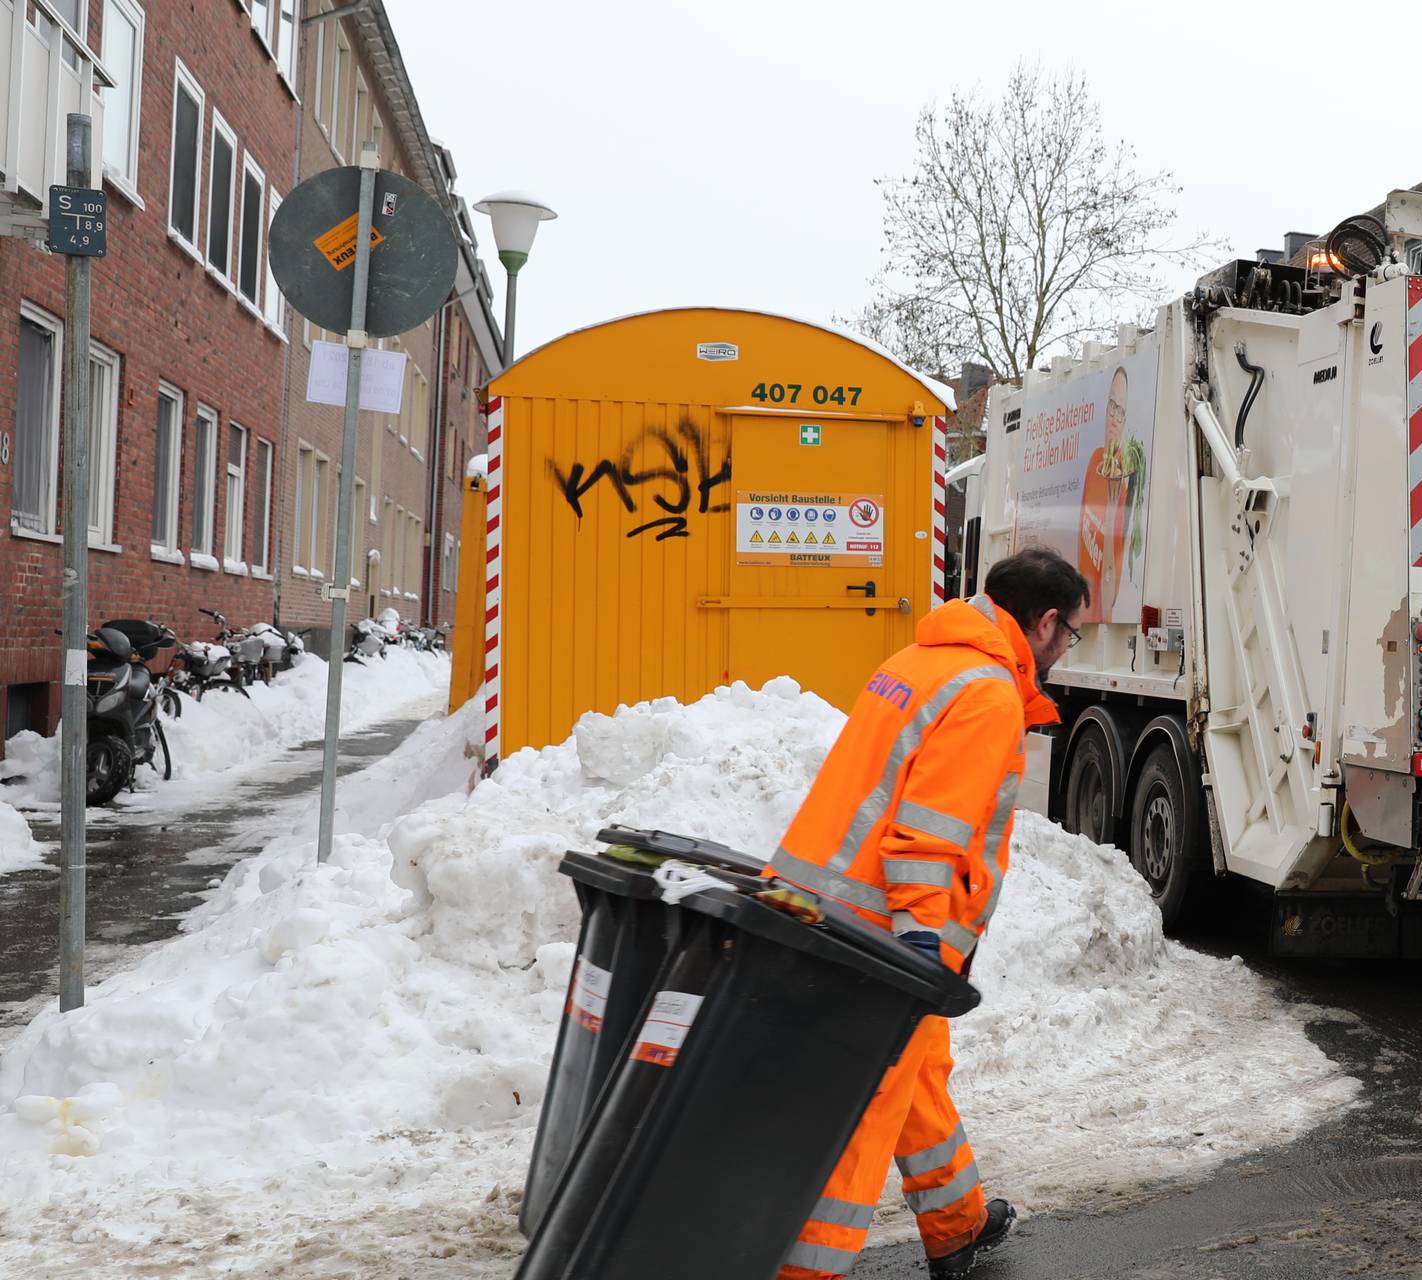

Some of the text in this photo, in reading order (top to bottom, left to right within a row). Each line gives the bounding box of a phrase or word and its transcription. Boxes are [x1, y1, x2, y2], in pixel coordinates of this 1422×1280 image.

[59, 195, 72, 210] S
[83, 203, 103, 213] 100
[751, 382, 863, 406] 407 047
[1025, 410, 1054, 445] Fleißige
[1055, 402, 1095, 433] Bakterien
[0, 432, 10, 465] 8
[1023, 431, 1080, 473] für faulen Müll
[749, 493, 789, 504] Vorsicht
[791, 495, 836, 505] Baustelle
[790, 553, 831, 561] BATTEUX
